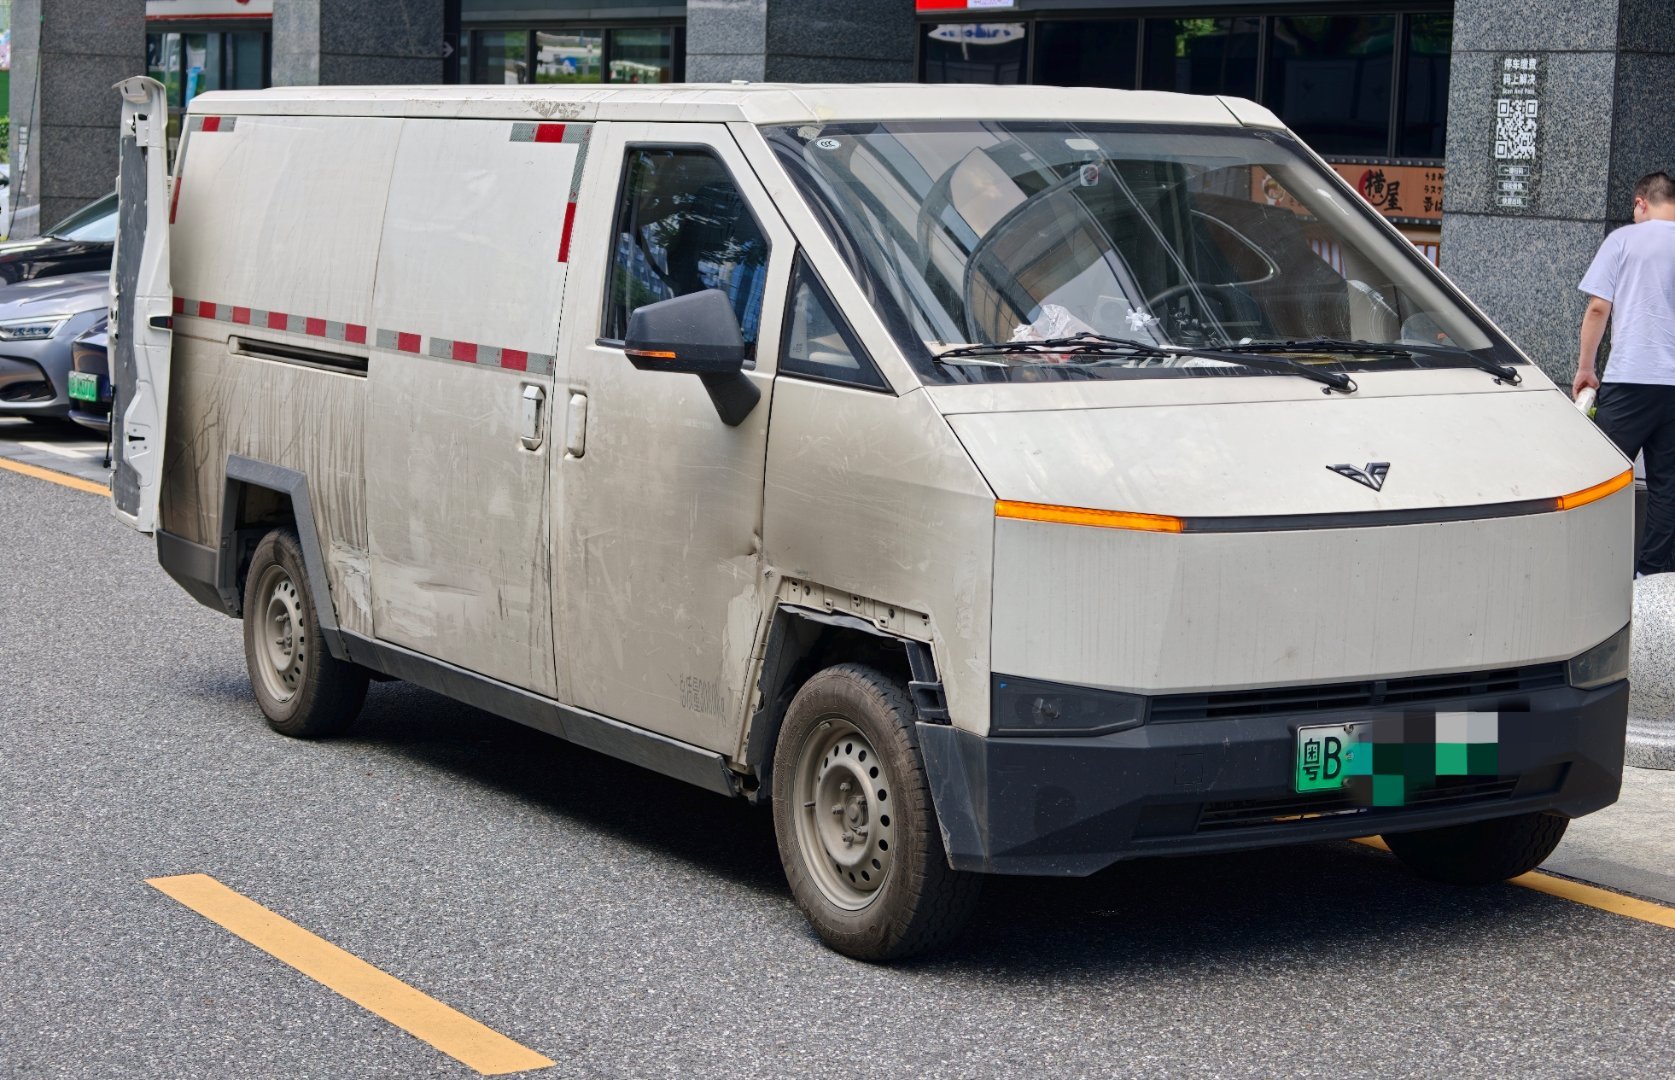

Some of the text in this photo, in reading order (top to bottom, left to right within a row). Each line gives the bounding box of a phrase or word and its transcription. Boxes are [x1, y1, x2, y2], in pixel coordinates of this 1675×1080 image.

[1503, 73, 1536, 85] 码上解决
[1303, 736, 1342, 782] 粤B
